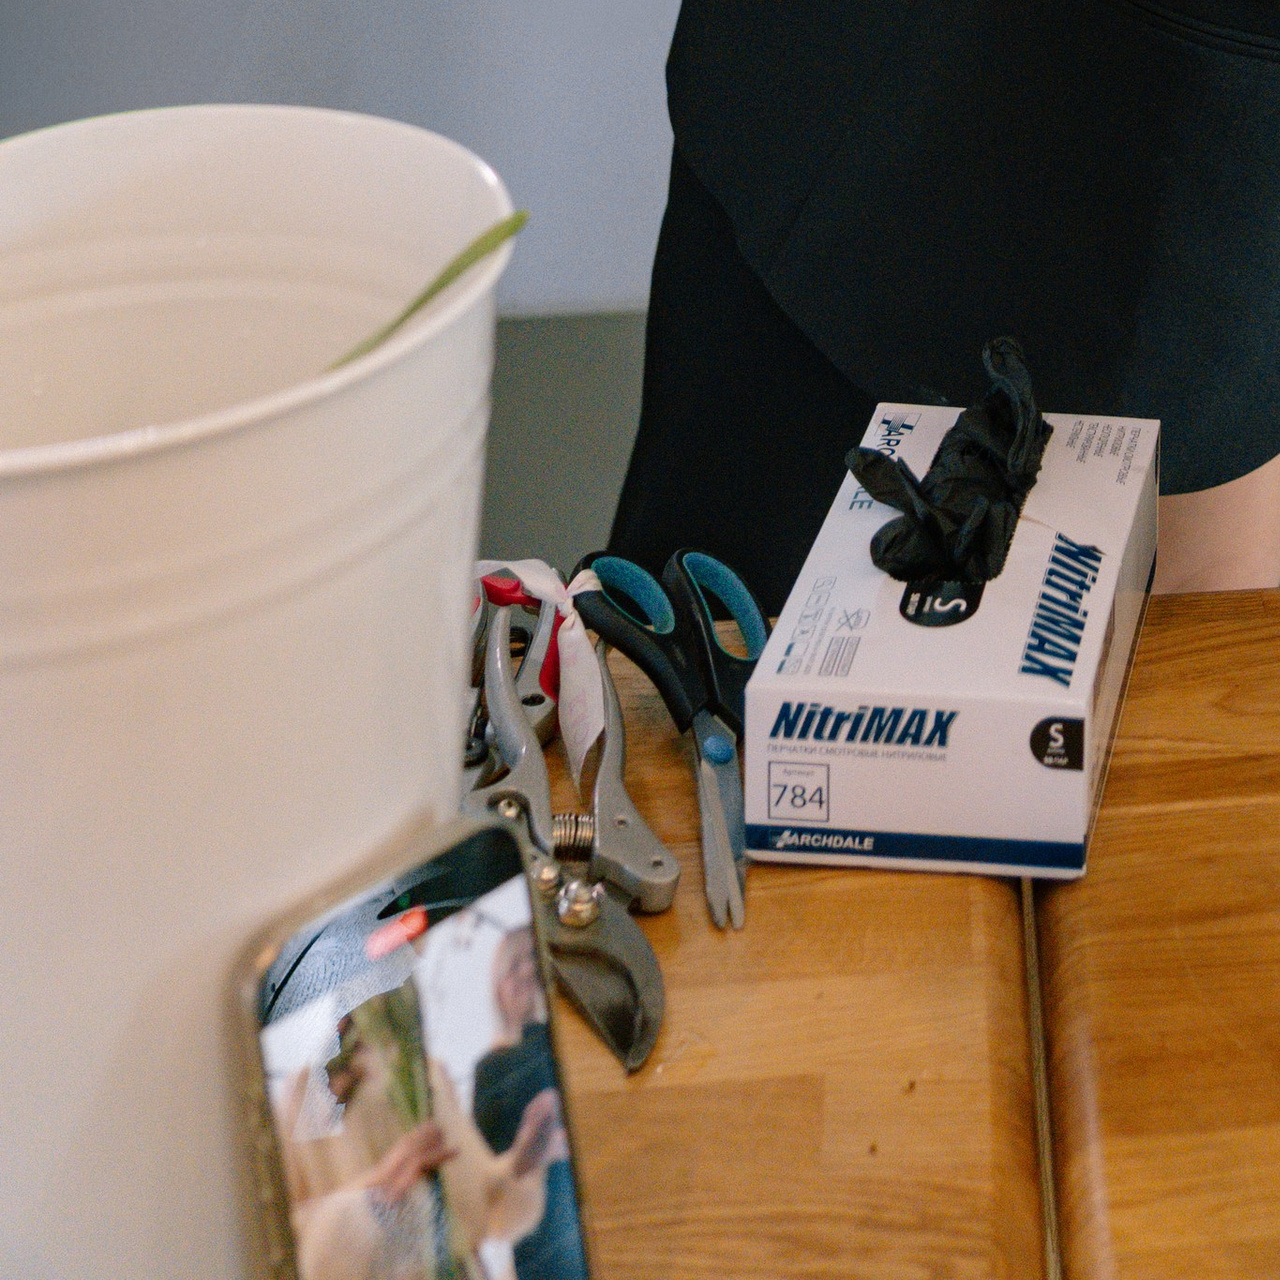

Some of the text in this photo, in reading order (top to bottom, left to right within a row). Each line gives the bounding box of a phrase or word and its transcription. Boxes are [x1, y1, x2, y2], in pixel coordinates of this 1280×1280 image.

[1018, 530, 1104, 688] NitriMAX
[769, 701, 960, 748] NitriMAX
[1048, 722, 1065, 748] S
[773, 783, 825, 810] 784
[788, 831, 875, 851] ARCHDALE
